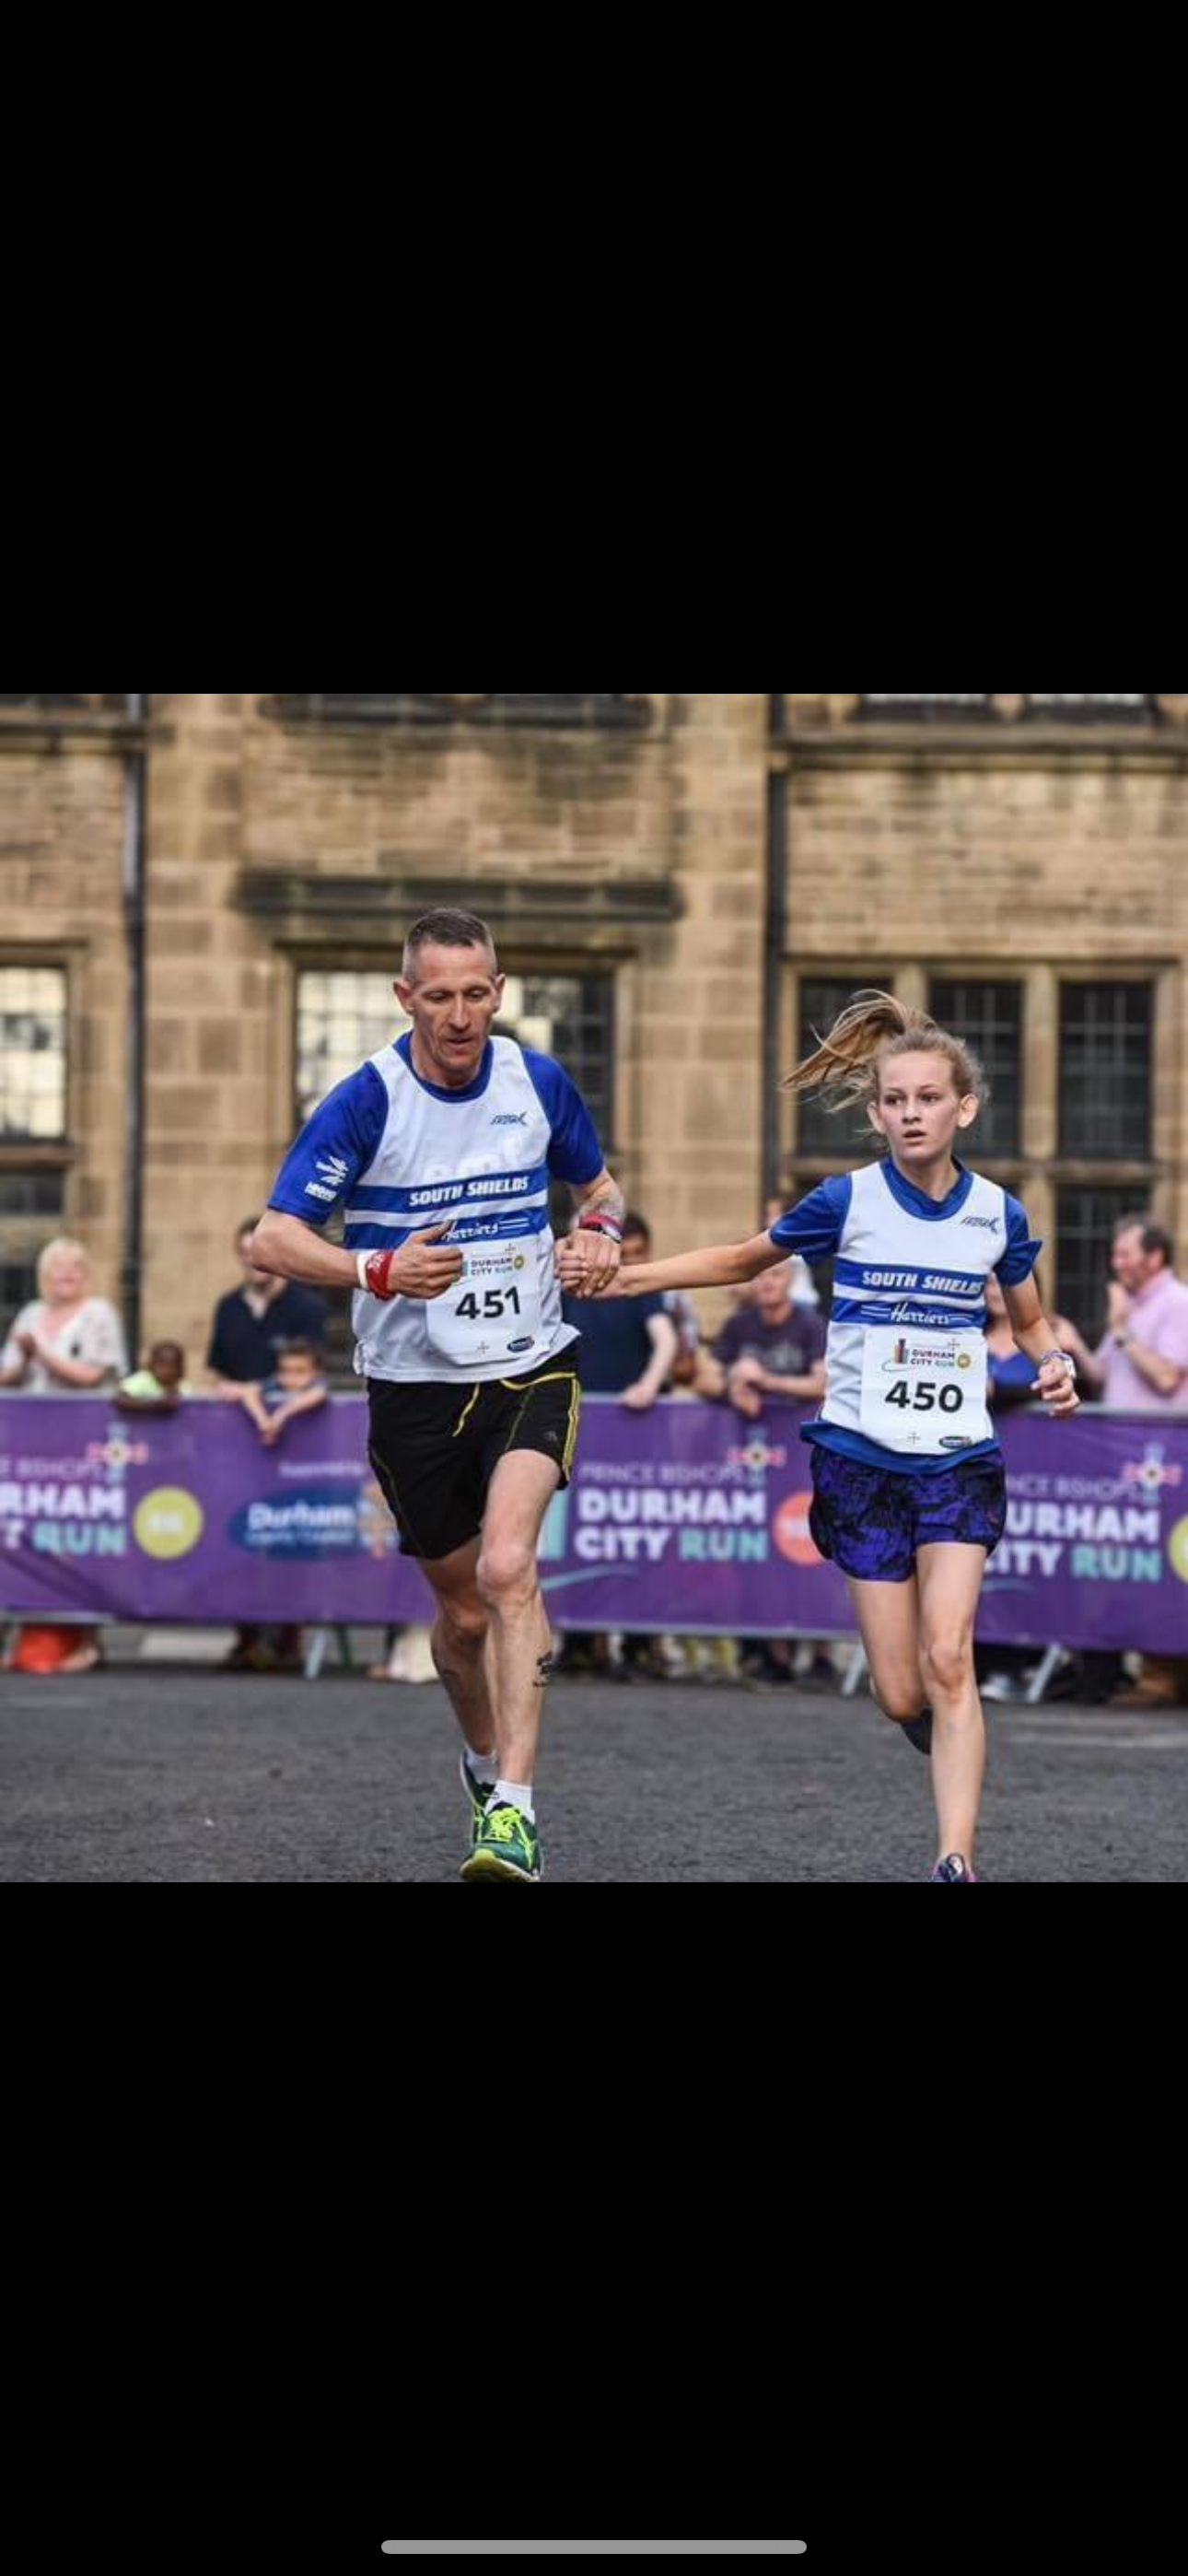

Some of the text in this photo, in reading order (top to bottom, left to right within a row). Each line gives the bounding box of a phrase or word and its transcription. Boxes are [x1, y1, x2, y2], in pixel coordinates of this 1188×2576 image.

[409, 1176, 530, 1207] SOUTH SHIELDS
[471, 1258, 513, 1269] DURHAM
[471, 1268, 492, 1276] CITY
[862, 1270, 918, 1288] SOUTH
[455, 1285, 520, 1319] 451
[891, 1302, 949, 1325] Harriers
[911, 1357, 932, 1366] CITY
[912, 1349, 955, 1359] DURHAM
[885, 1380, 963, 1413] 450
[0, 1482, 125, 1520] RHAM
[248, 1500, 357, 1529] Durham
[577, 1489, 767, 1524] DURHAM
[1007, 1500, 1160, 1544] URHAM
[33, 1521, 126, 1556] RUN
[575, 1526, 672, 1561] CITY
[679, 1528, 768, 1562] RUN
[984, 1540, 1064, 1577] ITY
[1071, 1544, 1161, 1583] RUN
